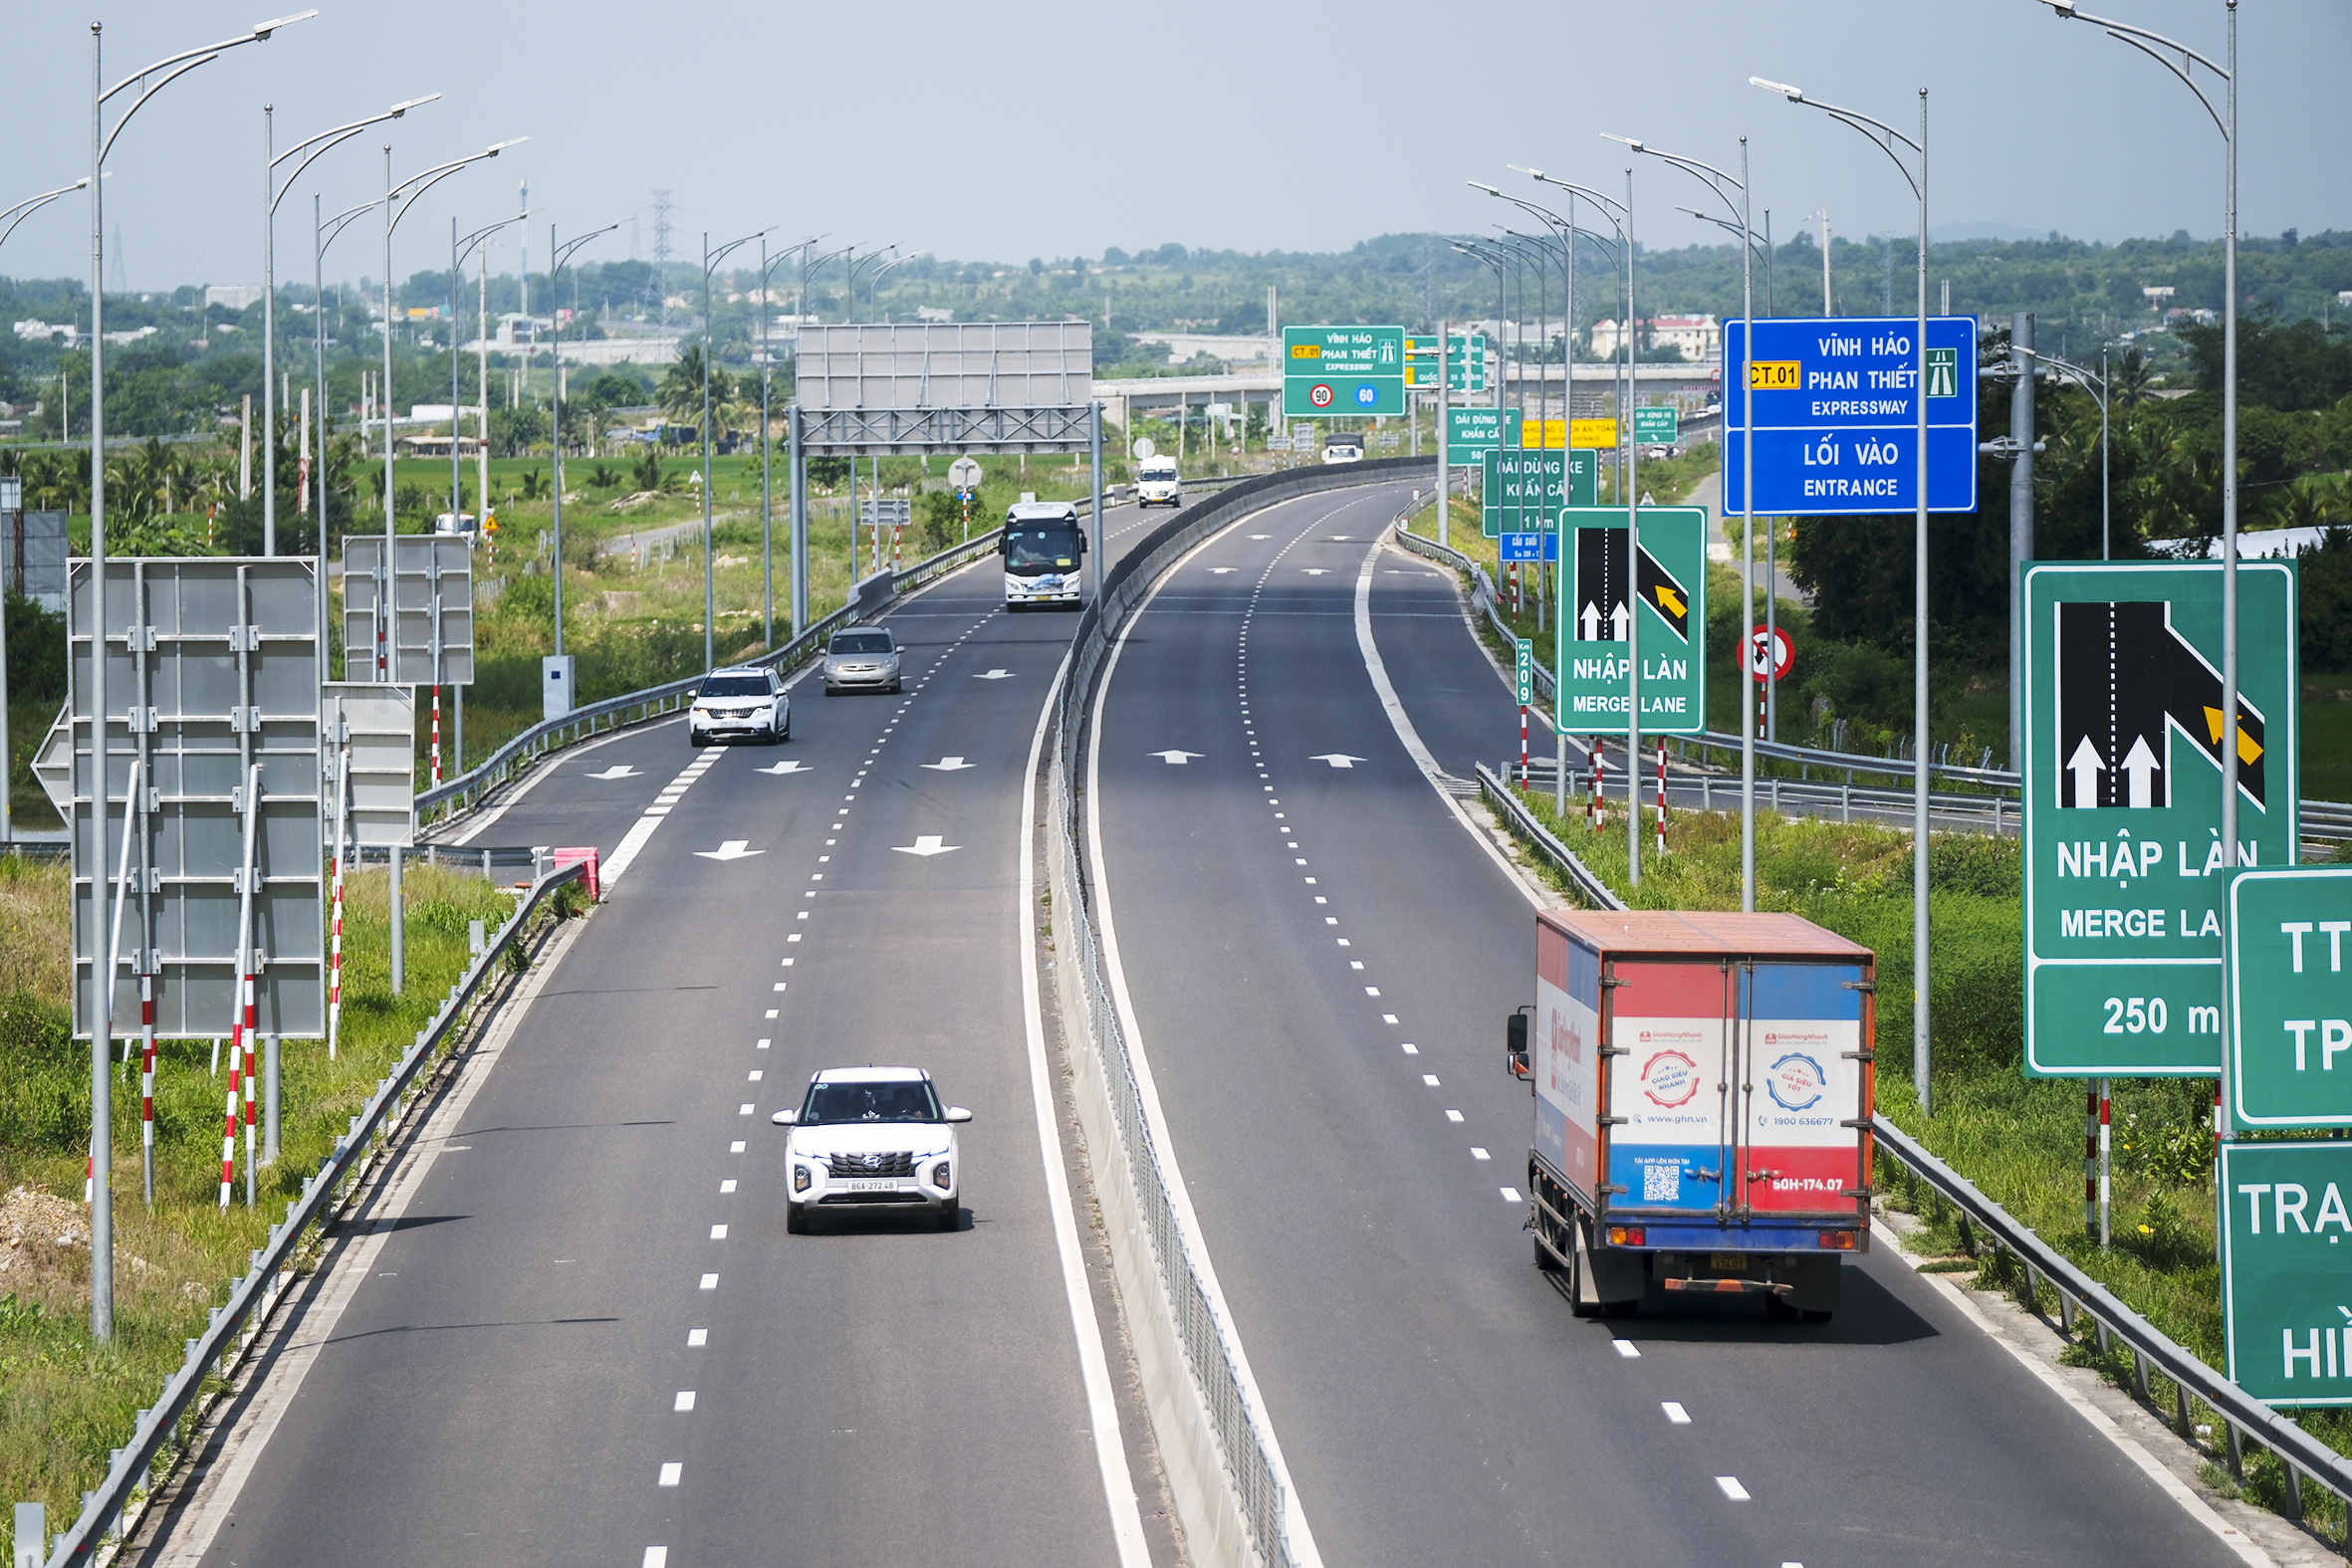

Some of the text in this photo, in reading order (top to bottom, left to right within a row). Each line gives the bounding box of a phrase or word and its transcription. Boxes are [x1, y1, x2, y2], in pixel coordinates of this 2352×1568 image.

[1818, 331, 1911, 356] VĨNH HẢO
[1321, 346, 1378, 359] PHAN THIẾT
[1751, 366, 1796, 383] CT.01
[1808, 362, 1918, 390] PHAN THIẾT
[1315, 389, 1327, 402] 90
[1358, 388, 1374, 403] 60
[1811, 400, 1908, 416] EXPRESSWAY
[1804, 433, 1899, 466] LỐI VÀO
[1804, 478, 1898, 497] ENTRANCE
[1524, 516, 1529, 529] 1
[1573, 652, 1687, 685] NHẬP LÀN
[1573, 696, 1687, 713] MERGE LANE
[2056, 827, 2257, 888] NHẬP LÀN
[2061, 909, 2222, 938] MERGE LA
[2280, 921, 2351, 974] TT
[2103, 997, 2220, 1034] 250 m
[2283, 1019, 2352, 1071] TP
[1651, 1069, 1688, 1084] GIAO SIÊU
[1658, 1078, 1686, 1090] NHANH
[1795, 1077, 1812, 1087] SIÊU
[1647, 1115, 1708, 1124] www.ghn.vn
[1773, 1117, 1834, 1126] 1900 636677
[1772, 1178, 1843, 1191] 50H-174.07
[2237, 1182, 2352, 1243] TRẠ
[2282, 1306, 2352, 1378] HI
